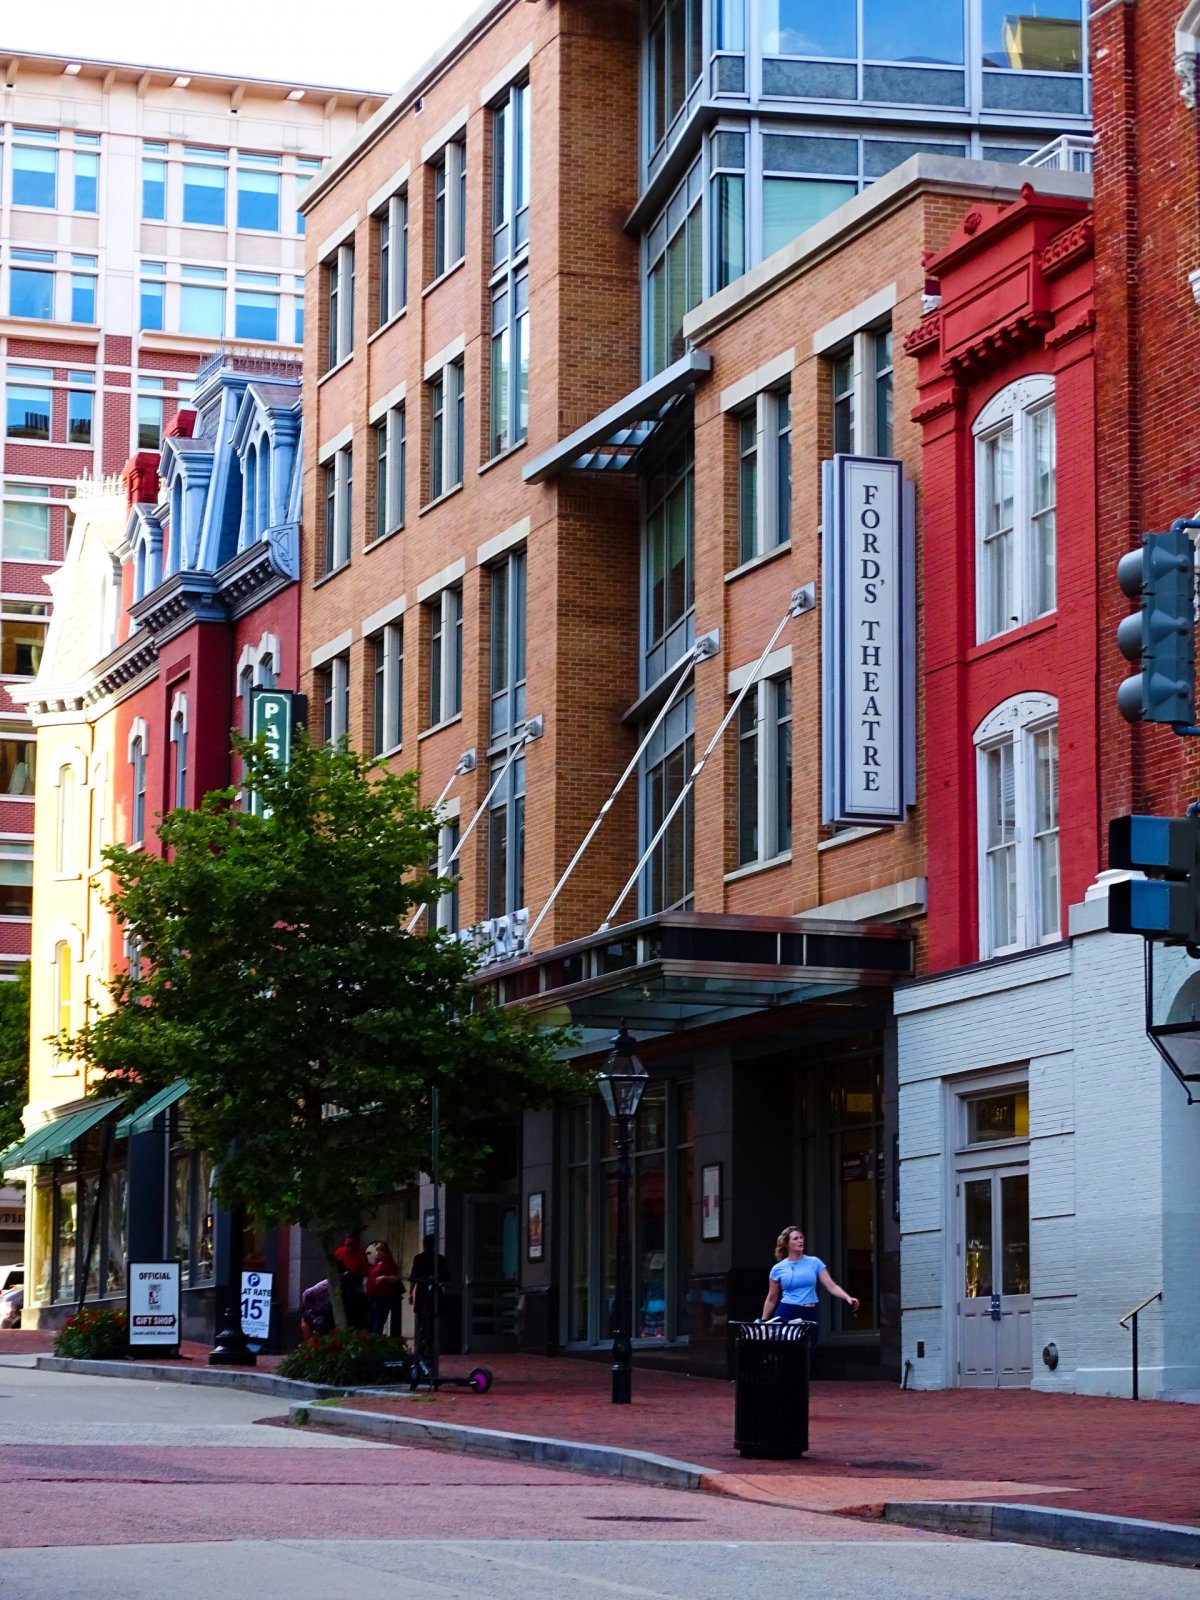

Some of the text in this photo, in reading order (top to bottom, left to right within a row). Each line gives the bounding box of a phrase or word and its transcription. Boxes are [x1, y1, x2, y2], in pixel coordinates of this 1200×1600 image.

[861, 485, 885, 792] FORD'S THEATRE
[138, 1272, 171, 1281] OFFICIAL
[241, 1288, 272, 1297] AT RATE
[241, 1298, 262, 1320] 15
[135, 1316, 174, 1325] GIFT SHOP
